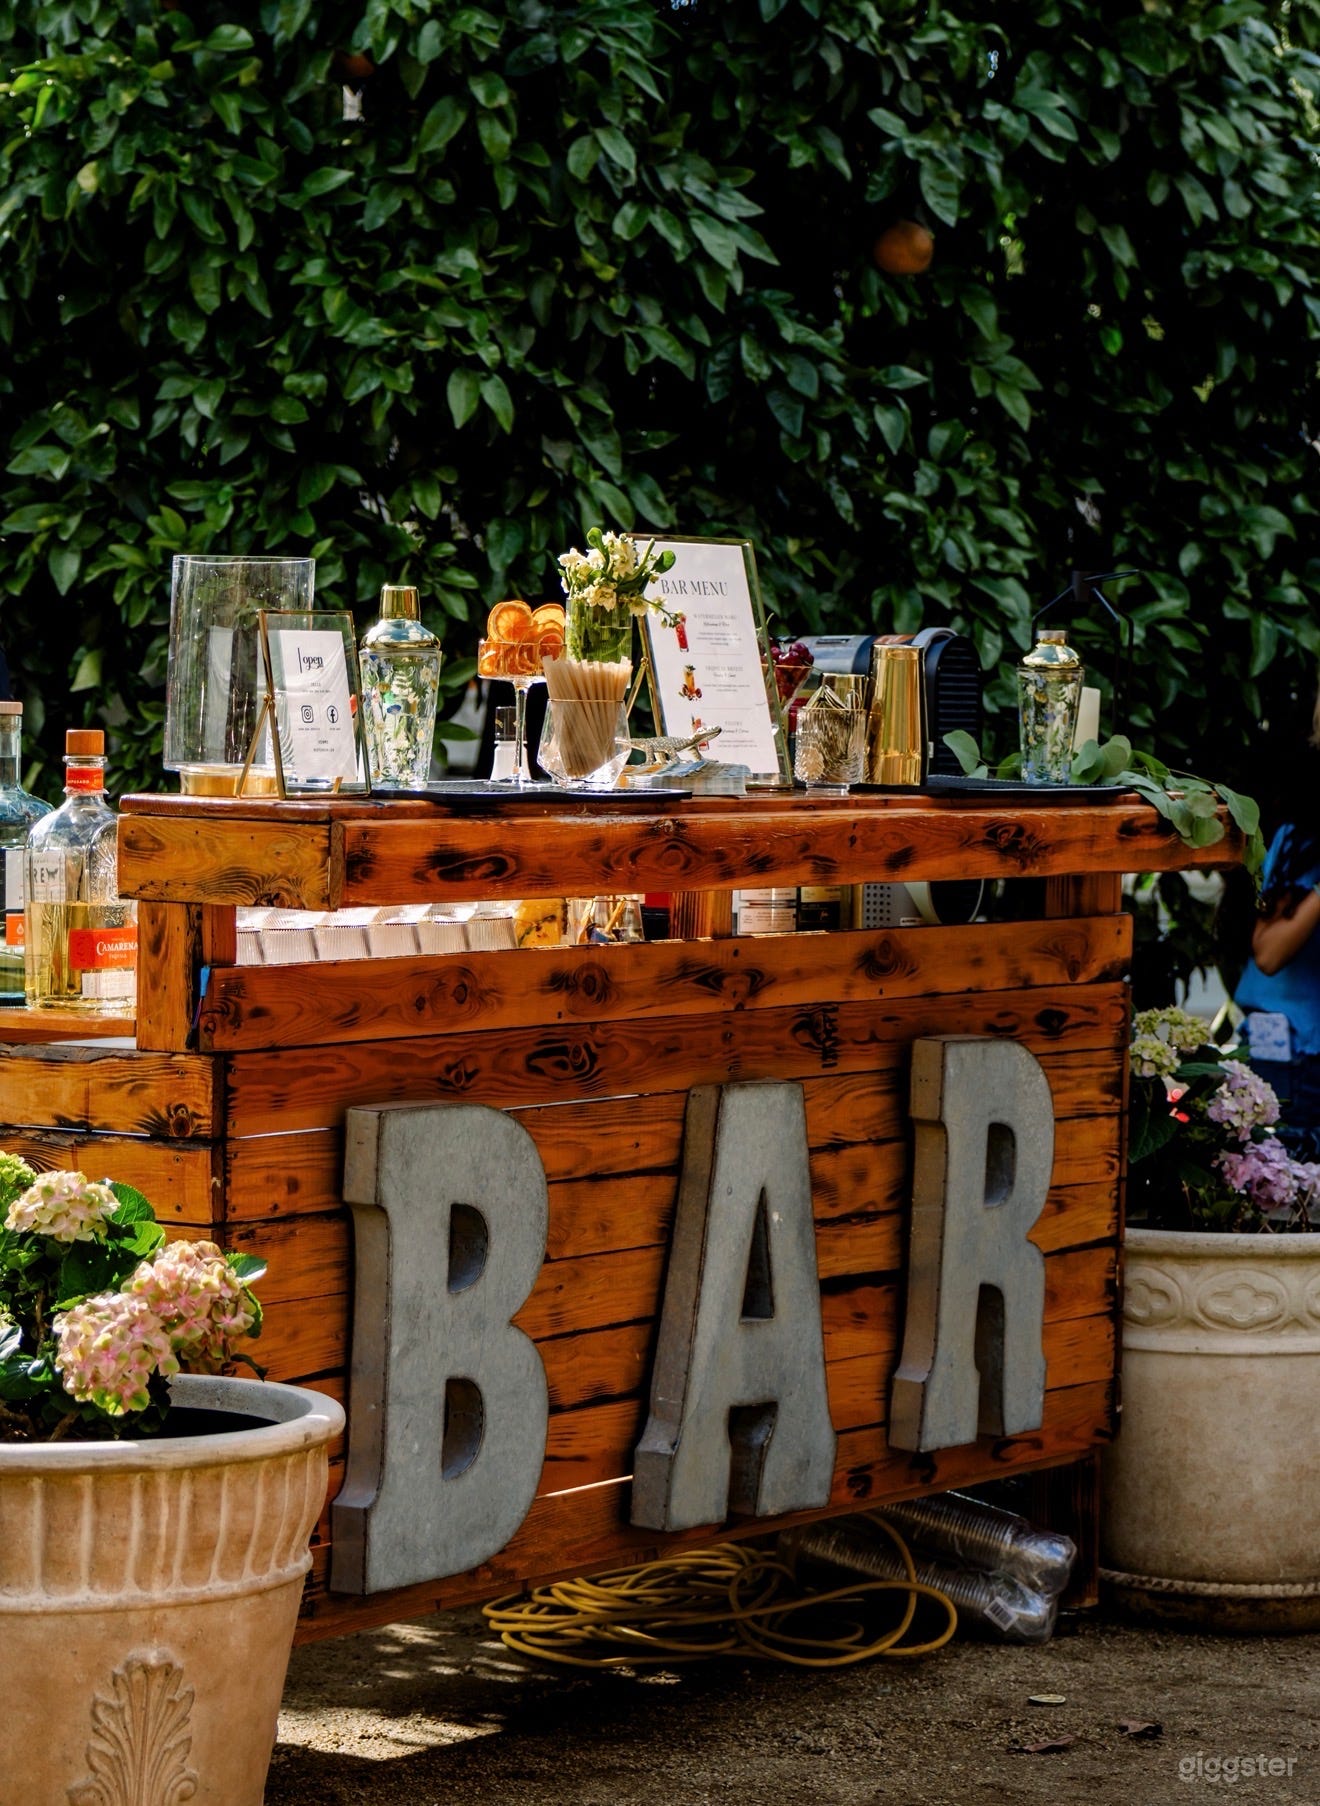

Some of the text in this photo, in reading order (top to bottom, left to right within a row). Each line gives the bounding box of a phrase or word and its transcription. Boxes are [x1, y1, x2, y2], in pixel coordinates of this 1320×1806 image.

[661, 579, 728, 597] BAR MENU
[302, 656, 323, 670] open
[96, 940, 138, 956] CAMARENA
[330, 1034, 1056, 1596] BAR
